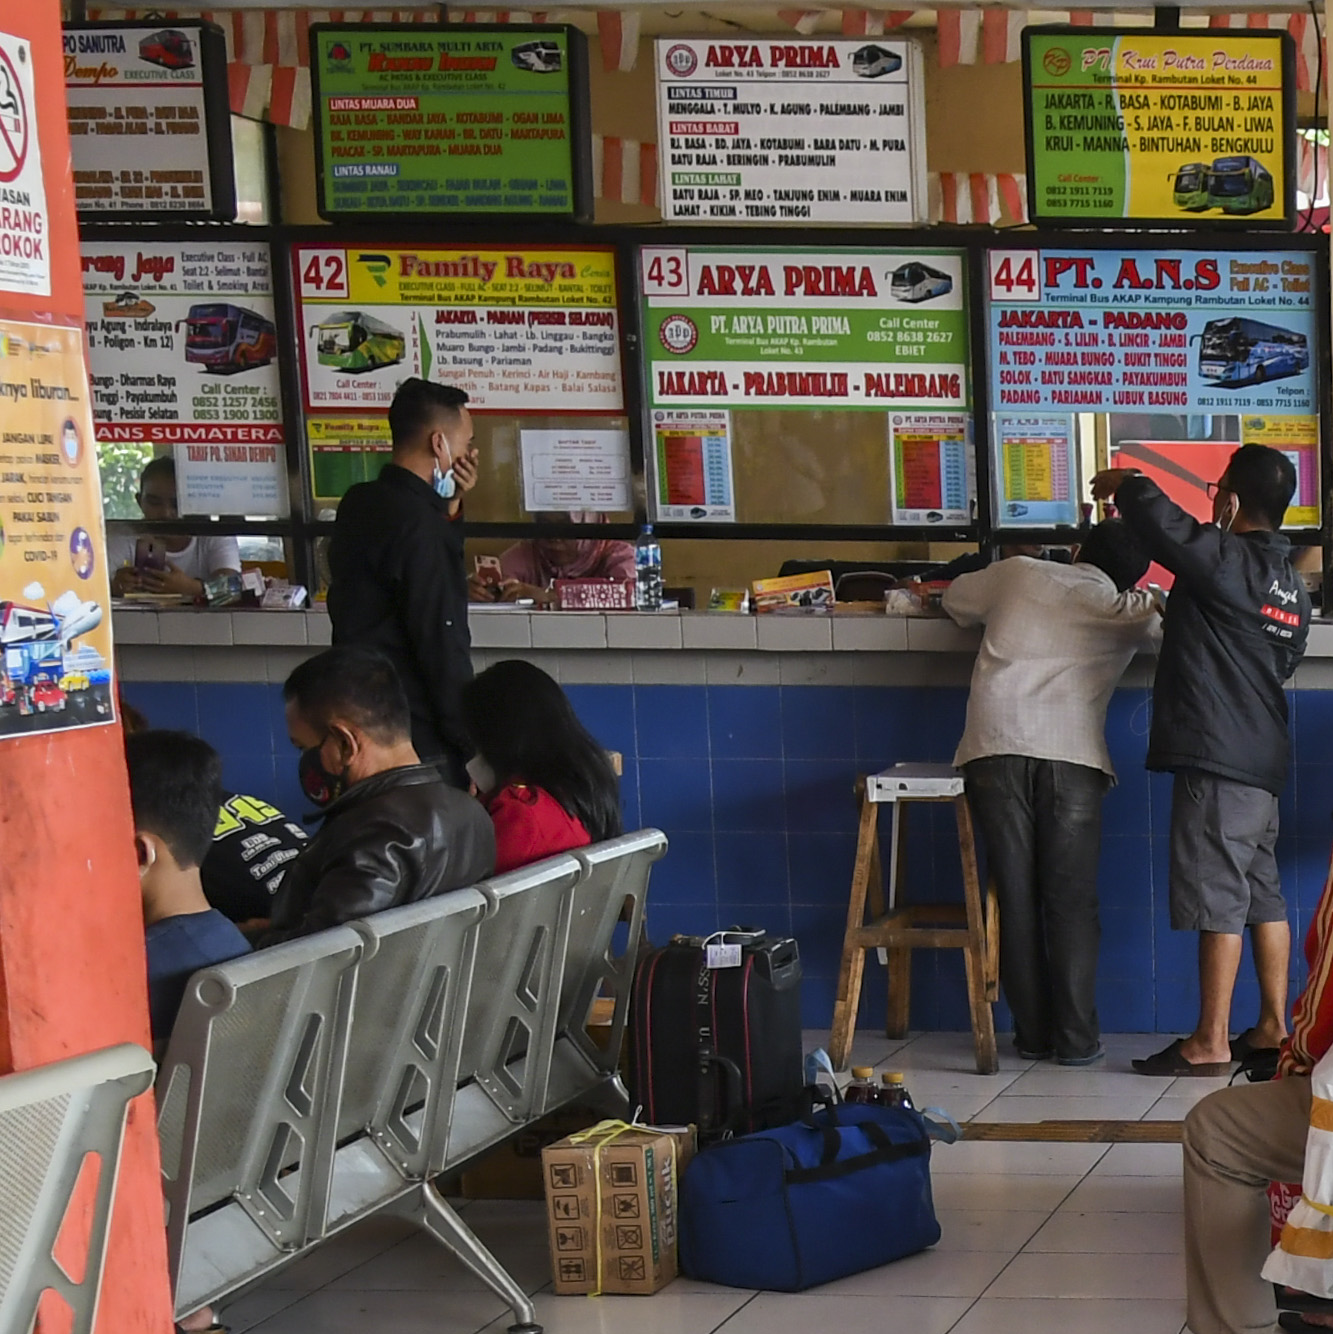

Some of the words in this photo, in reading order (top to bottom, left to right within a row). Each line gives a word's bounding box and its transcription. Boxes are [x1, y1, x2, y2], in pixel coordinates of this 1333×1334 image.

[78, 35, 125, 53] SANUTRA
[706, 45, 763, 68] ARYA
[770, 46, 840, 68] PRIMA
[1122, 51, 1157, 70] Krui
[1163, 50, 1206, 70] Putra
[1212, 51, 1273, 71] Perdana
[124, 70, 168, 79] EXECUTIVE
[171, 69, 195, 79] CLASS
[671, 88, 701, 99] LINTAS
[704, 88, 734, 99] TIMUR
[331, 99, 359, 109] LINTAS
[362, 99, 394, 109] MUARA
[397, 99, 415, 109] DUA
[669, 103, 715, 115] MENGGALA
[733, 103, 761, 114] MULYO
[770, 104, 778, 115] K.
[781, 104, 811, 115] AGUNG
[820, 104, 870, 116] PALEMBANG
[879, 105, 904, 116] JAMBI
[1045, 95, 1095, 109] JAKARTA
[1106, 95, 1116, 110] R.
[1120, 95, 1150, 110] BASA
[1160, 95, 1222, 110] KOTABUMI
[1233, 96, 1244, 111] B.
[1247, 96, 1273, 111] JAYA
[304, 256, 344, 290] 42
[399, 256, 497, 281] Family
[505, 257, 576, 280] Raya
[647, 256, 683, 287] 43
[994, 257, 1035, 293] 44
[1044, 257, 1103, 288] PT.
[1113, 259, 1220, 290] A.N.S
[697, 266, 775, 296] ARYA
[784, 266, 877, 296] PRIMA
[1045, 293, 1087, 303] Terminal
[1090, 294, 1109, 303] Bus
[1112, 294, 1141, 303] AKAP
[1144, 295, 1192, 307] Kampung
[1194, 295, 1245, 305] Rambutan
[1248, 295, 1276, 305] Loket
[1278, 296, 1296, 305] No.
[1297, 296, 1310, 305] 44
[879, 318, 900, 329] Call
[903, 318, 939, 329] Center
[998, 311, 1084, 328] JAKARTA
[1103, 312, 1187, 329] PADANG
[436, 330, 486, 339] Prabumulih
[494, 330, 518, 339] Lahat
[526, 331, 539, 340] Lb.
[541, 331, 574, 342] Linggau
[583, 332, 614, 343] Bangko
[867, 331, 893, 342] 0852
[896, 332, 923, 342] 8638
[926, 332, 953, 343] 2627
[895, 345, 925, 356] EBIET
[201, 384, 221, 394] Call
[224, 385, 260, 395] Center
[659, 371, 728, 396] JAKARTA
[744, 372, 848, 397] PRABUMULIH
[865, 373, 960, 398] PALEMBANG
[193, 397, 219, 407] 0852
[222, 397, 247, 407] 1257
[152, 427, 282, 440] SUMATERA
